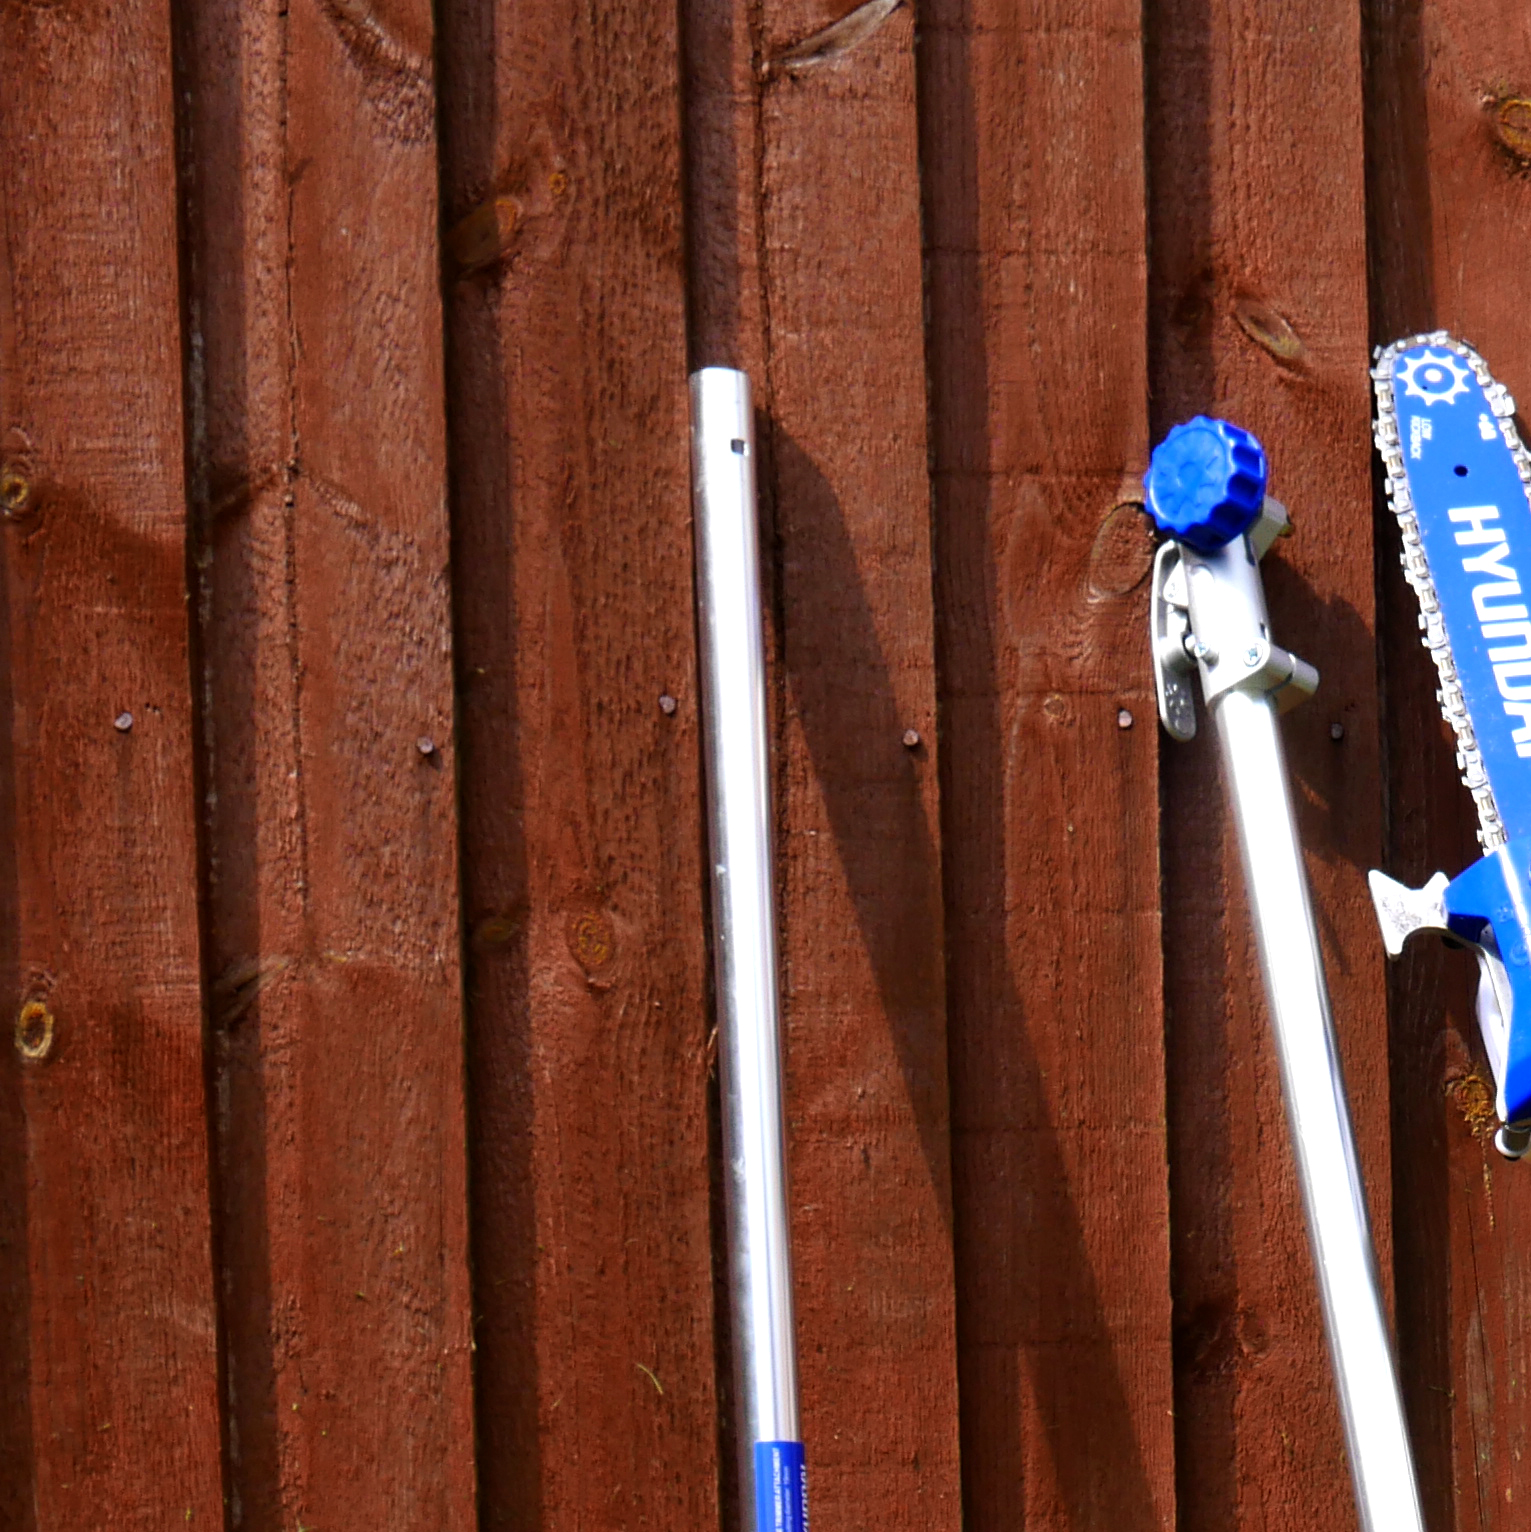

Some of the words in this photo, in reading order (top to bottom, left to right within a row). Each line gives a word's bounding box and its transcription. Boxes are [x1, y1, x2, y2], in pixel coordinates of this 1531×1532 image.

[1421, 418, 1433, 441] LOW
[772, 1447, 781, 1495] ATTACHMENT
[774, 1495, 783, 1527] TRIMMER
